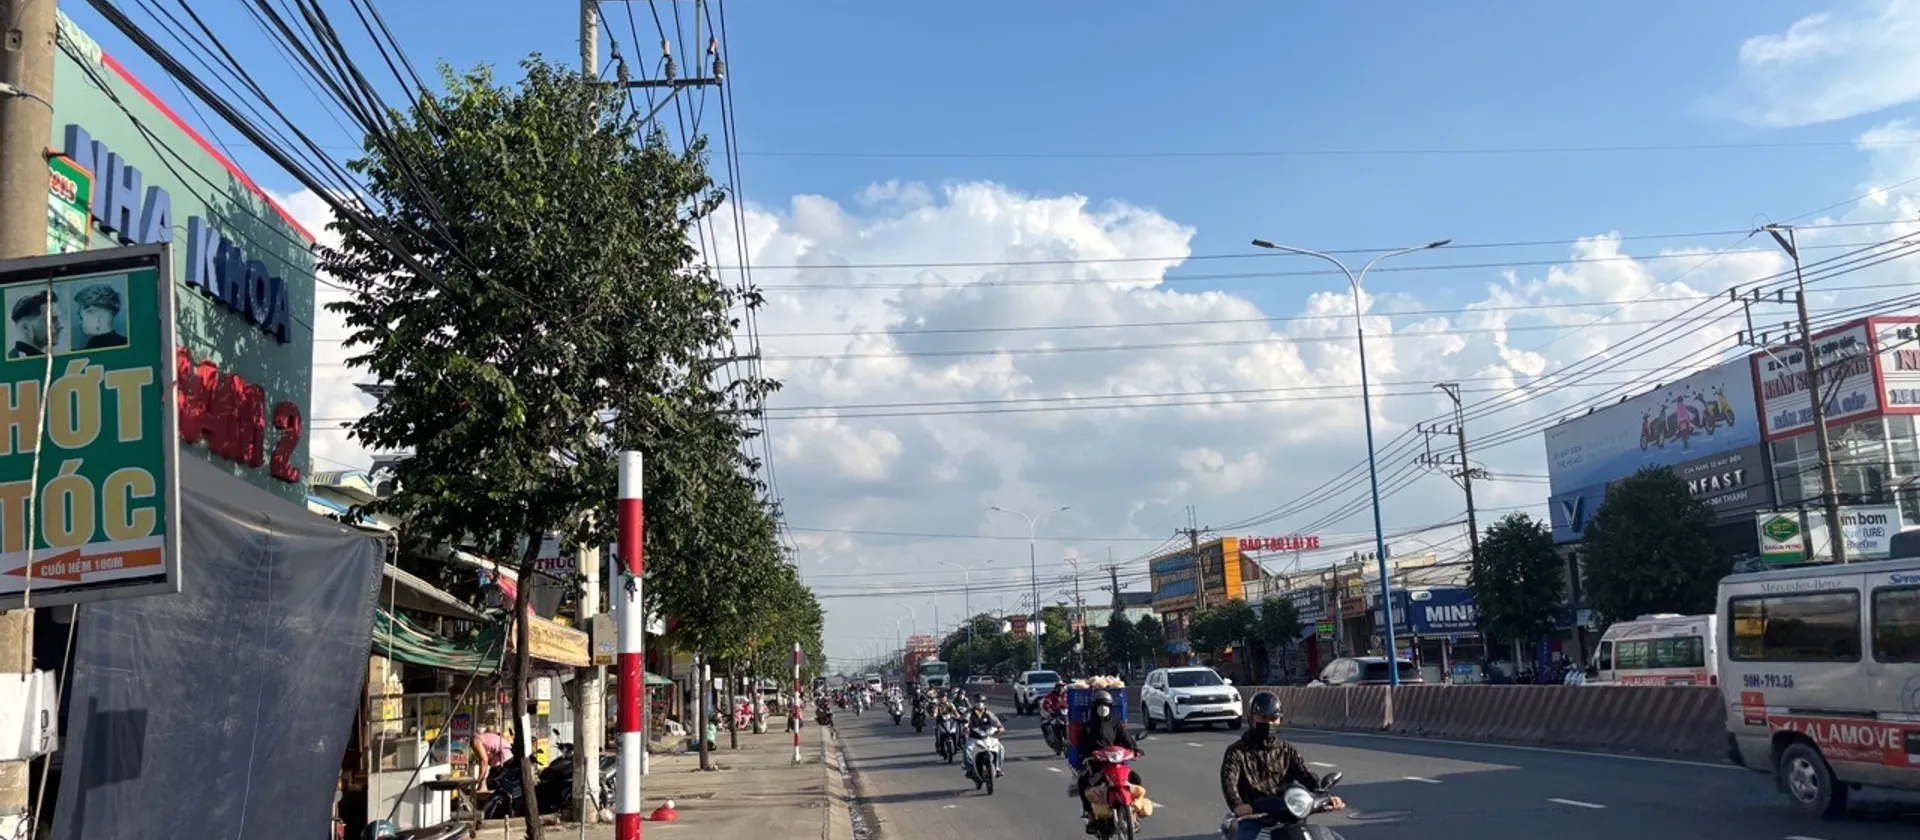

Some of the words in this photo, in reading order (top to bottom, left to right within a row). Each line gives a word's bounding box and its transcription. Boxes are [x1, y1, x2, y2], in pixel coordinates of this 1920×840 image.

[65, 124, 172, 243] NHA
[186, 215, 291, 343] KHOA
[0, 358, 153, 455] HỚT
[0, 459, 157, 553] TÓC
[1688, 469, 1743, 496] NFAST
[1863, 526, 1886, 539] (URE)
